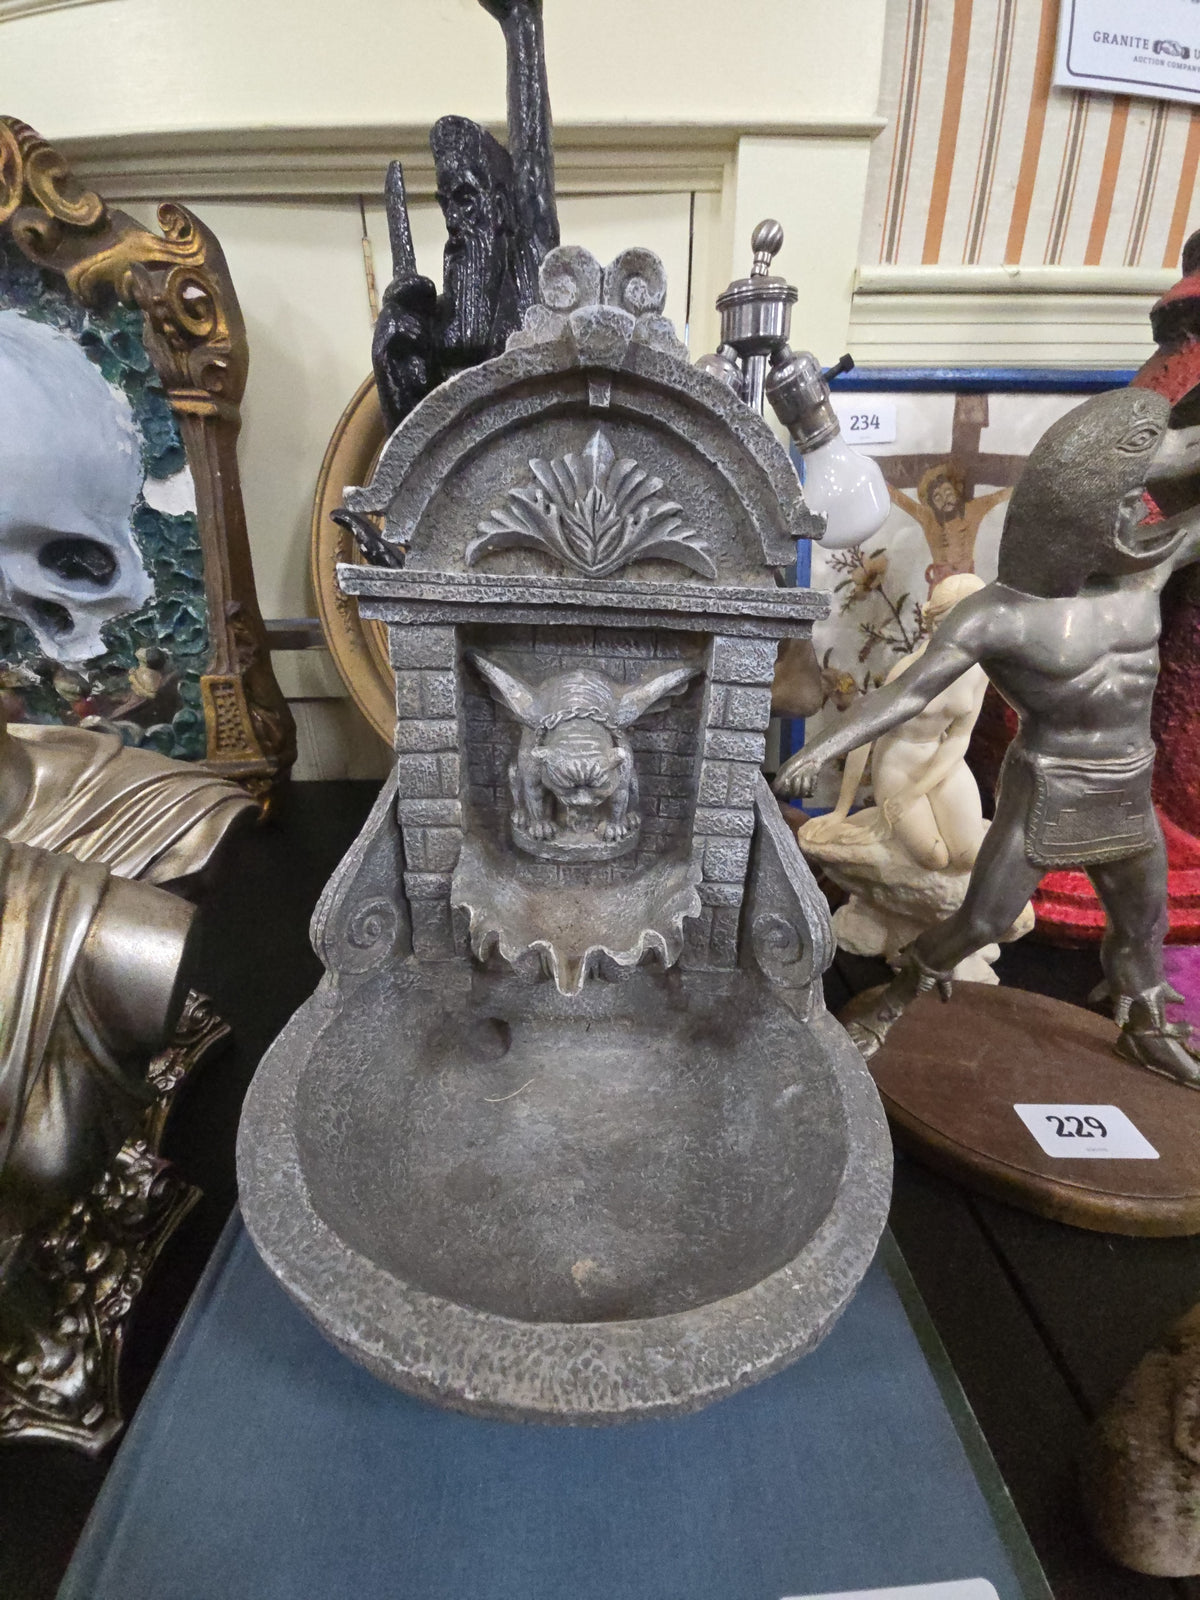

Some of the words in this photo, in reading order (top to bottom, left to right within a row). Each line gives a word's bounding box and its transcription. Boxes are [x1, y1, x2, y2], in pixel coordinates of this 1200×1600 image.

[1093, 31, 1149, 50] GRANITE
[1133, 55, 1165, 66] AUCTION
[850, 414, 880, 431] 234
[1045, 1115, 1108, 1138] 229
